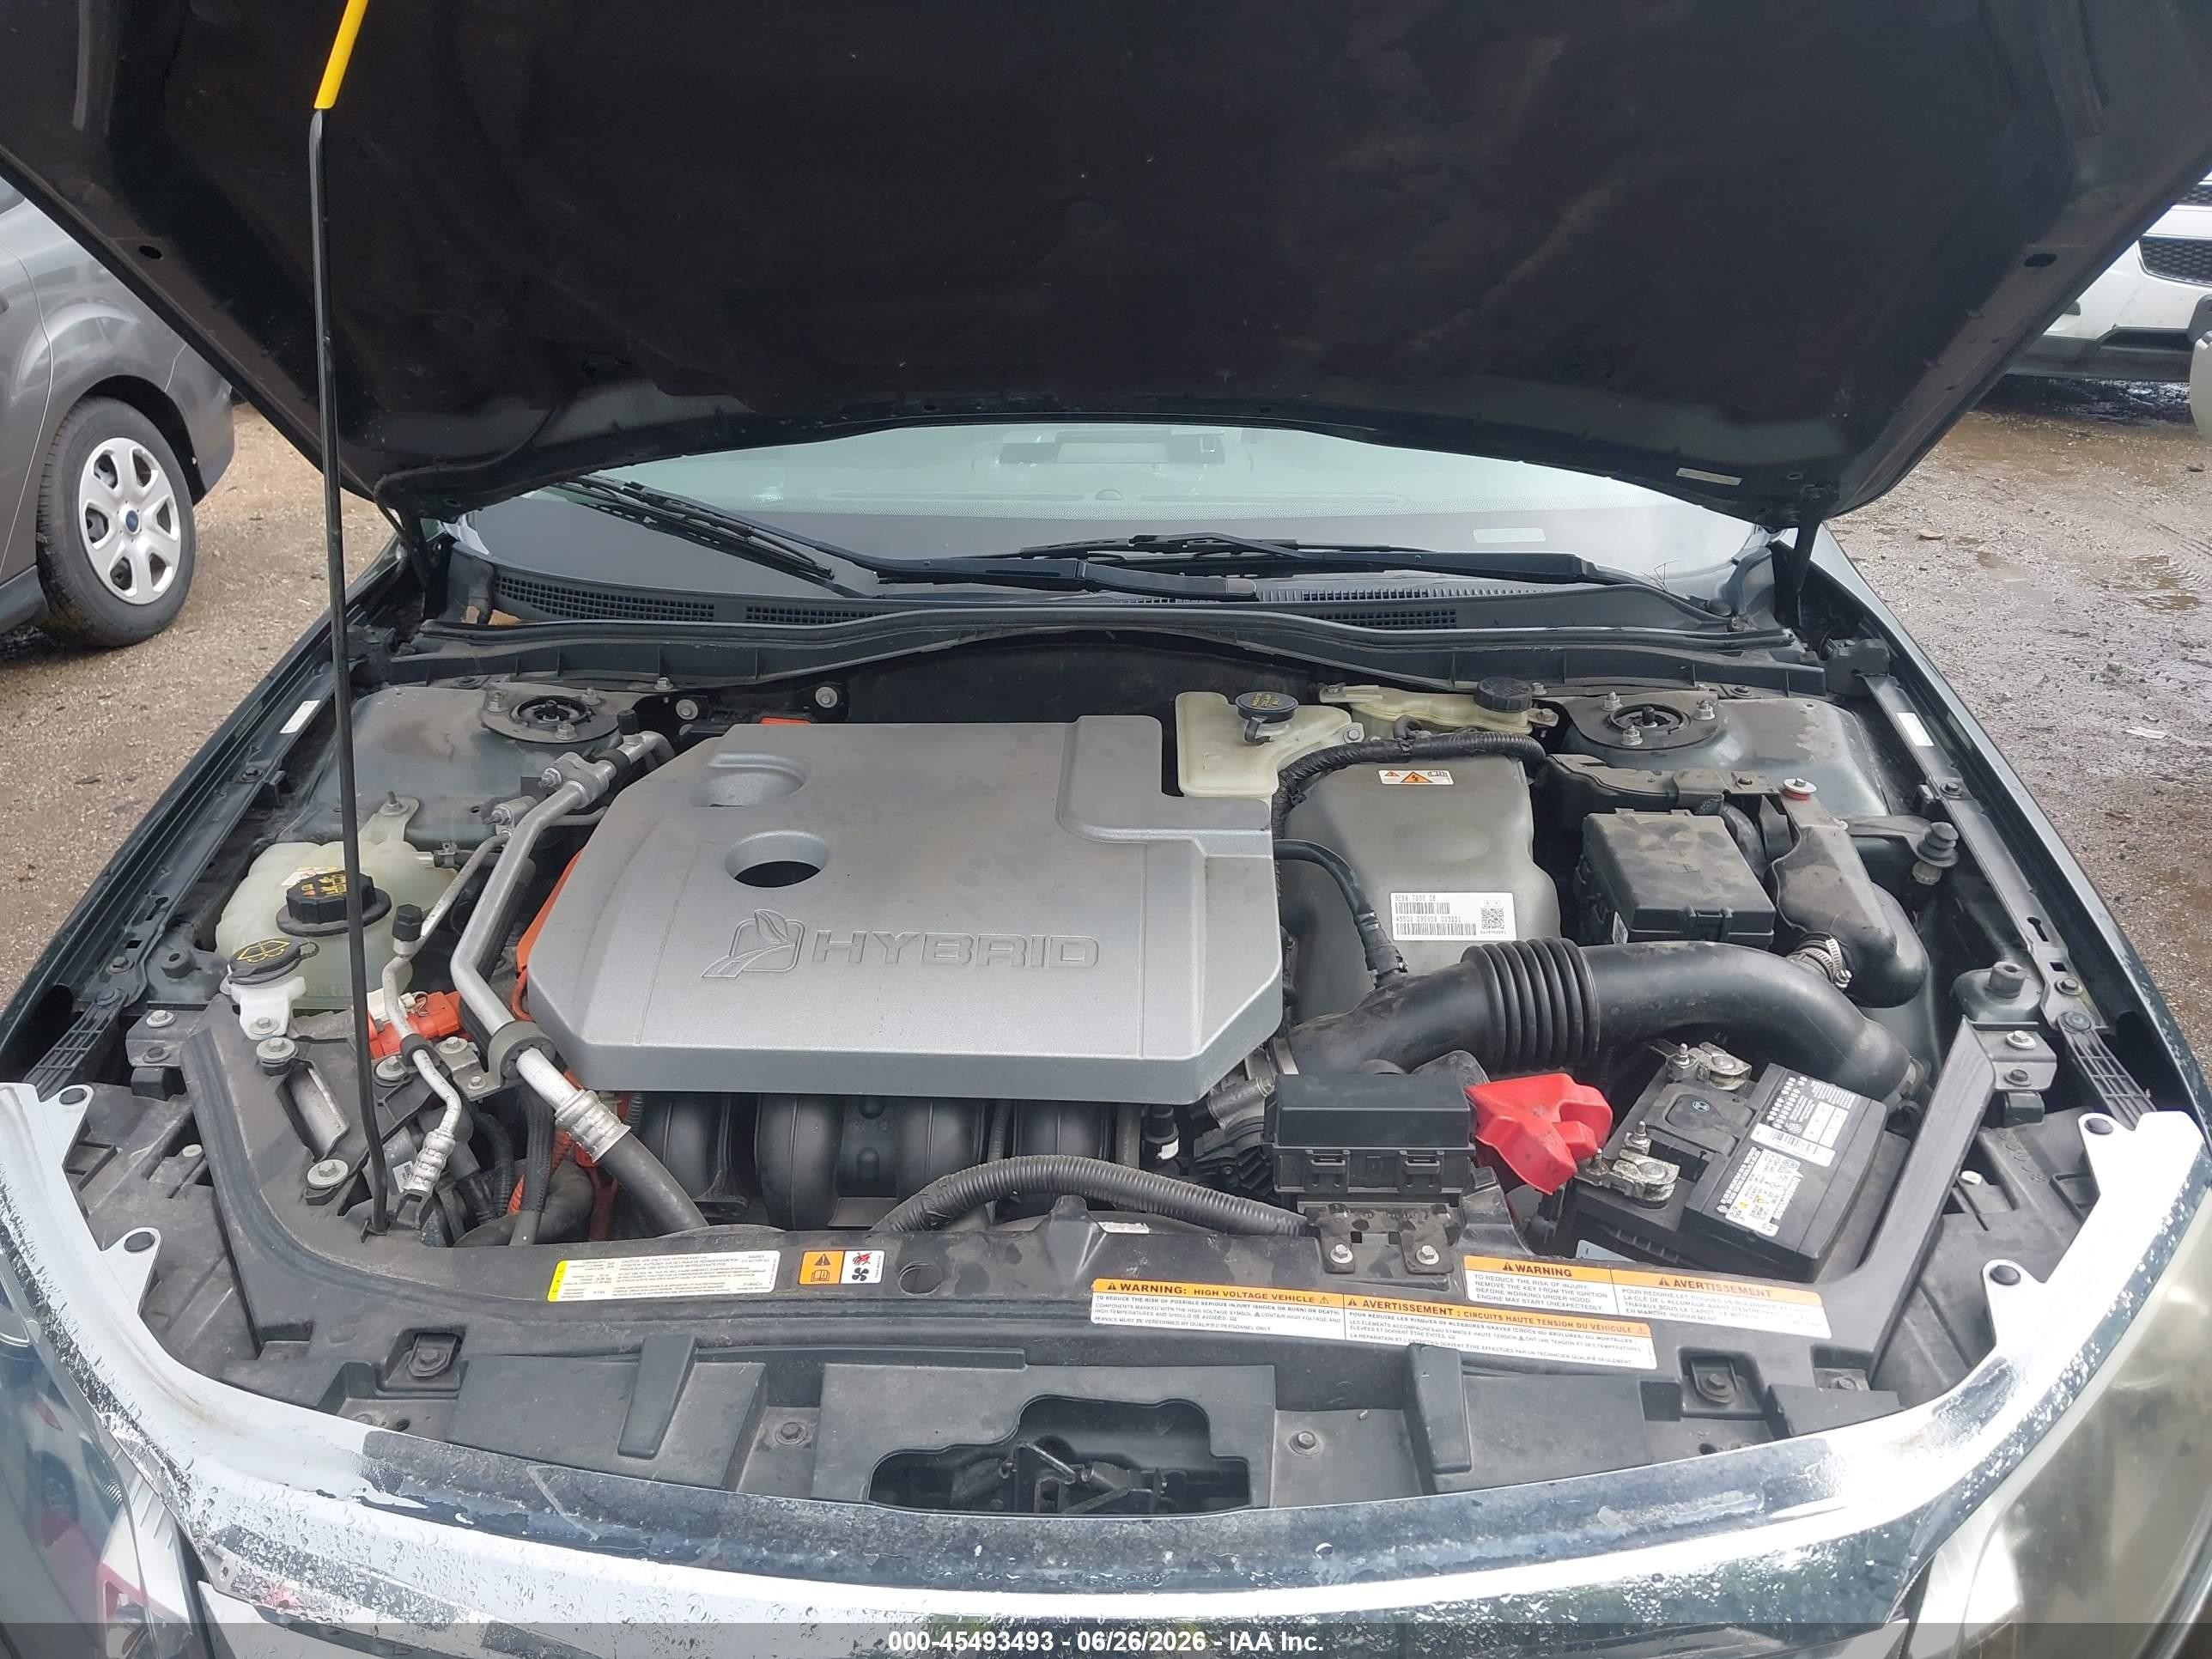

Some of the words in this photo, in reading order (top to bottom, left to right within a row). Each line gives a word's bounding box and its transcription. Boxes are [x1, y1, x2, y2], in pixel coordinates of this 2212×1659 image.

[811, 930, 1099, 969] HYBRID
[1515, 1264, 1572, 1277] WARNING
[1120, 1283, 1187, 1294] WARNING:
[1223, 1291, 1267, 1299] VOLTAGE
[1272, 1294, 1316, 1303] VEHICLE
[1674, 1279, 1772, 1297] AVERTISSEMENT
[1363, 1300, 1454, 1316] AVERTISSEMENT
[1464, 1311, 1504, 1321] CIRCUITS
[1506, 1316, 1534, 1324] HAUTE
[1538, 1318, 1573, 1328] TENSION
[1590, 1322, 1632, 1333] VÉHICULE
